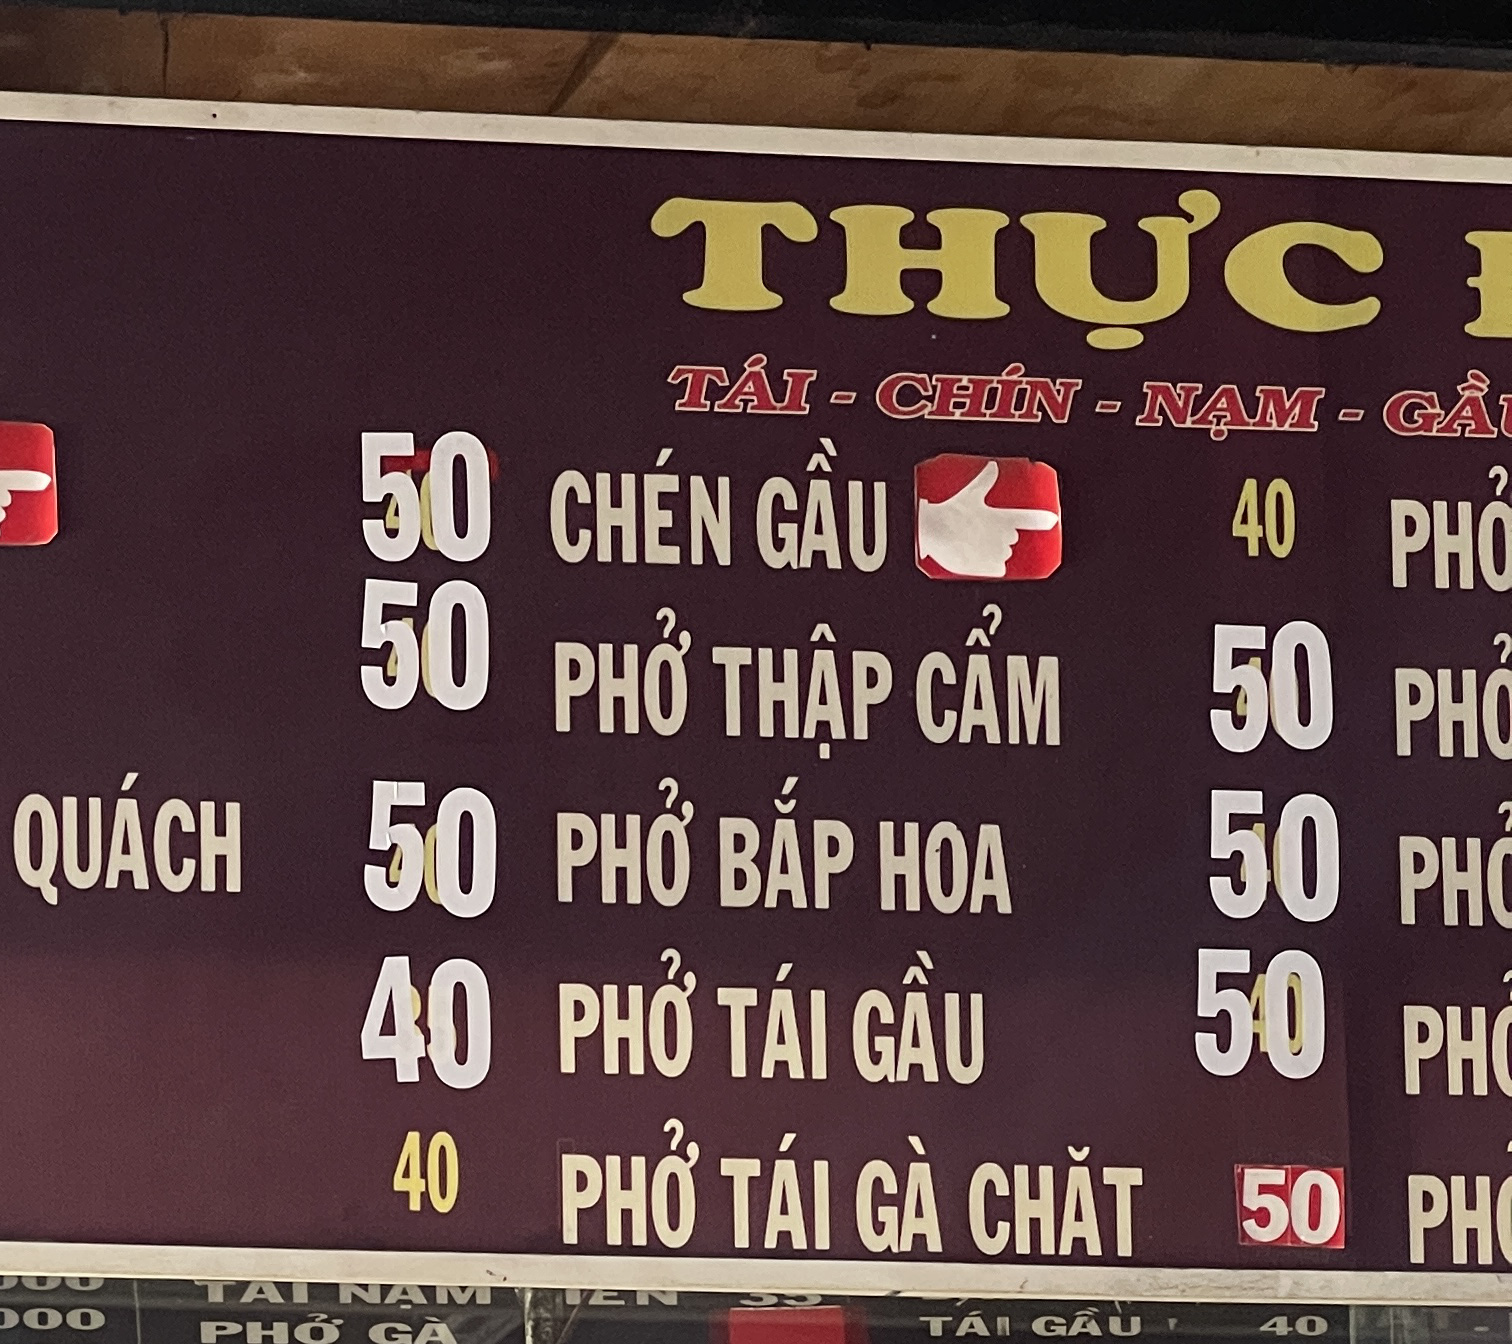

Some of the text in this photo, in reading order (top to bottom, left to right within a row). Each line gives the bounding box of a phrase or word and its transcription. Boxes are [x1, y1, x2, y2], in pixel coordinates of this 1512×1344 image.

[651, 189, 1384, 350] THỰC
[668, 355, 1512, 441] TÁI CHÍN NẠM GẦ
[361, 431, 492, 563] 50
[551, 439, 888, 572] CHÉN GẦU
[1232, 479, 1295, 557] 40
[361, 579, 490, 710] 50
[555, 604, 1061, 759] PHỞ THẬP CẨM
[1210, 620, 1333, 753] 50
[14, 773, 242, 905] QUÁCH
[363, 779, 496, 918] 50
[558, 777, 1012, 914] PHỞ BẮP HOA
[1209, 789, 1339, 922] 50
[361, 955, 491, 1088] 40
[559, 948, 984, 1085] PHỞ TÁI GẦU
[1194, 949, 1325, 1079] 50
[392, 1131, 458, 1212] 40
[561, 1118, 1143, 1257] PHỞ TÁI GÀ CHĂT
[1240, 1167, 1342, 1243] 50
[200, 1313, 344, 1344] PHỞ
[919, 1307, 1328, 1336] TÁI GẦU 40
